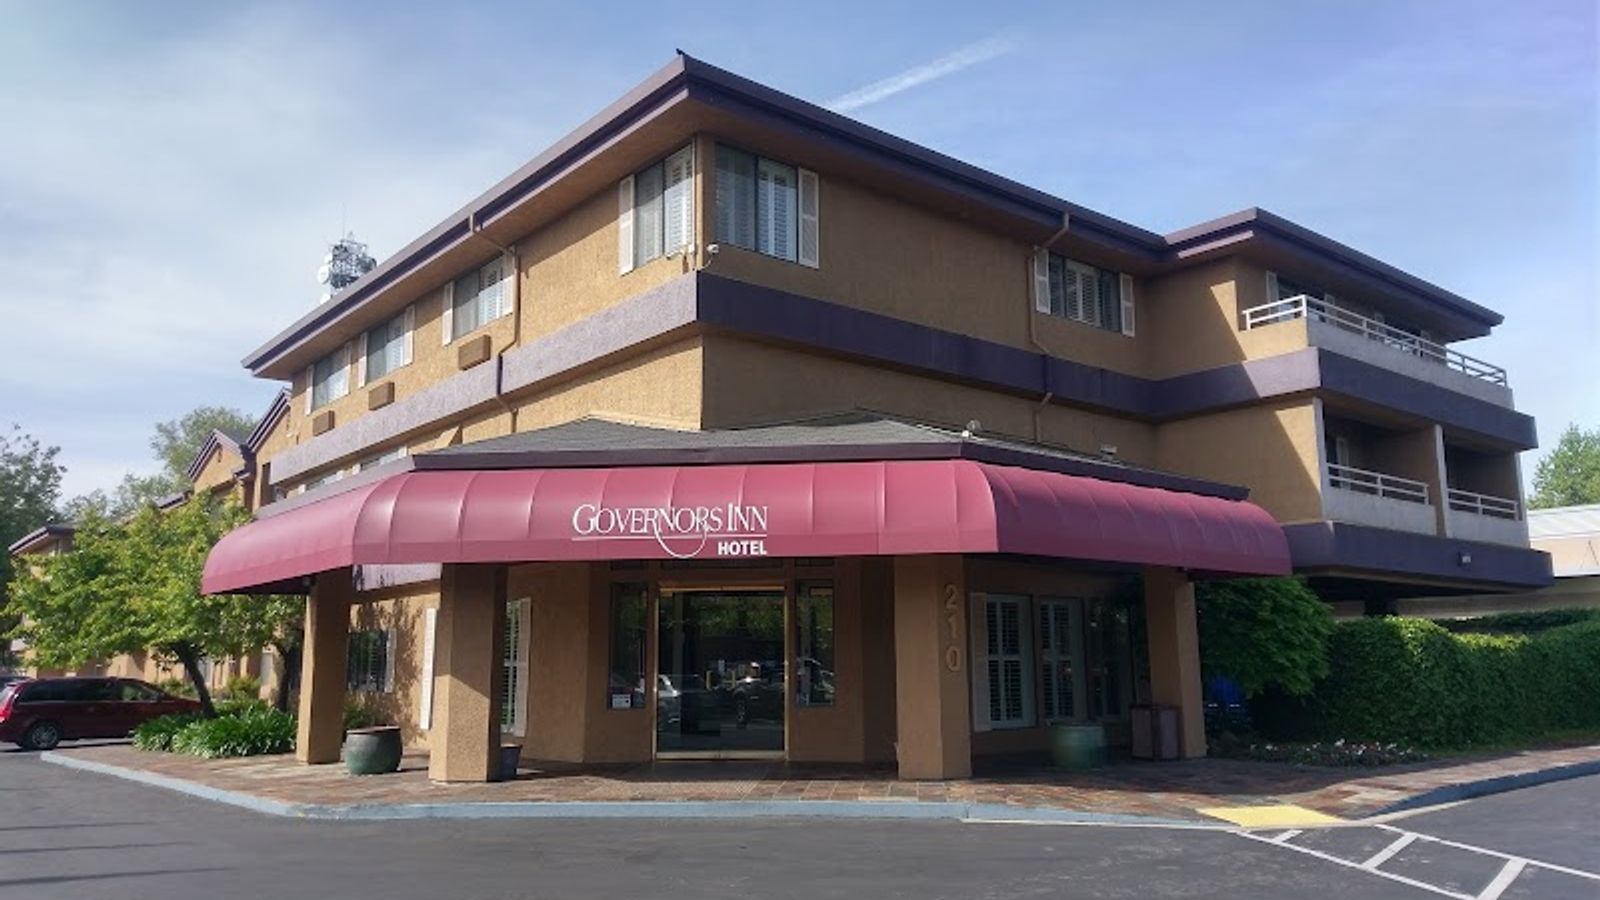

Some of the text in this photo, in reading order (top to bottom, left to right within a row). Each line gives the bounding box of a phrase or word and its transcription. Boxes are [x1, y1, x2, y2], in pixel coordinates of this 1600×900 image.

[572, 503, 768, 536] GOVERNORS INN
[717, 540, 768, 556] HOTEL
[943, 582, 961, 673] 210
